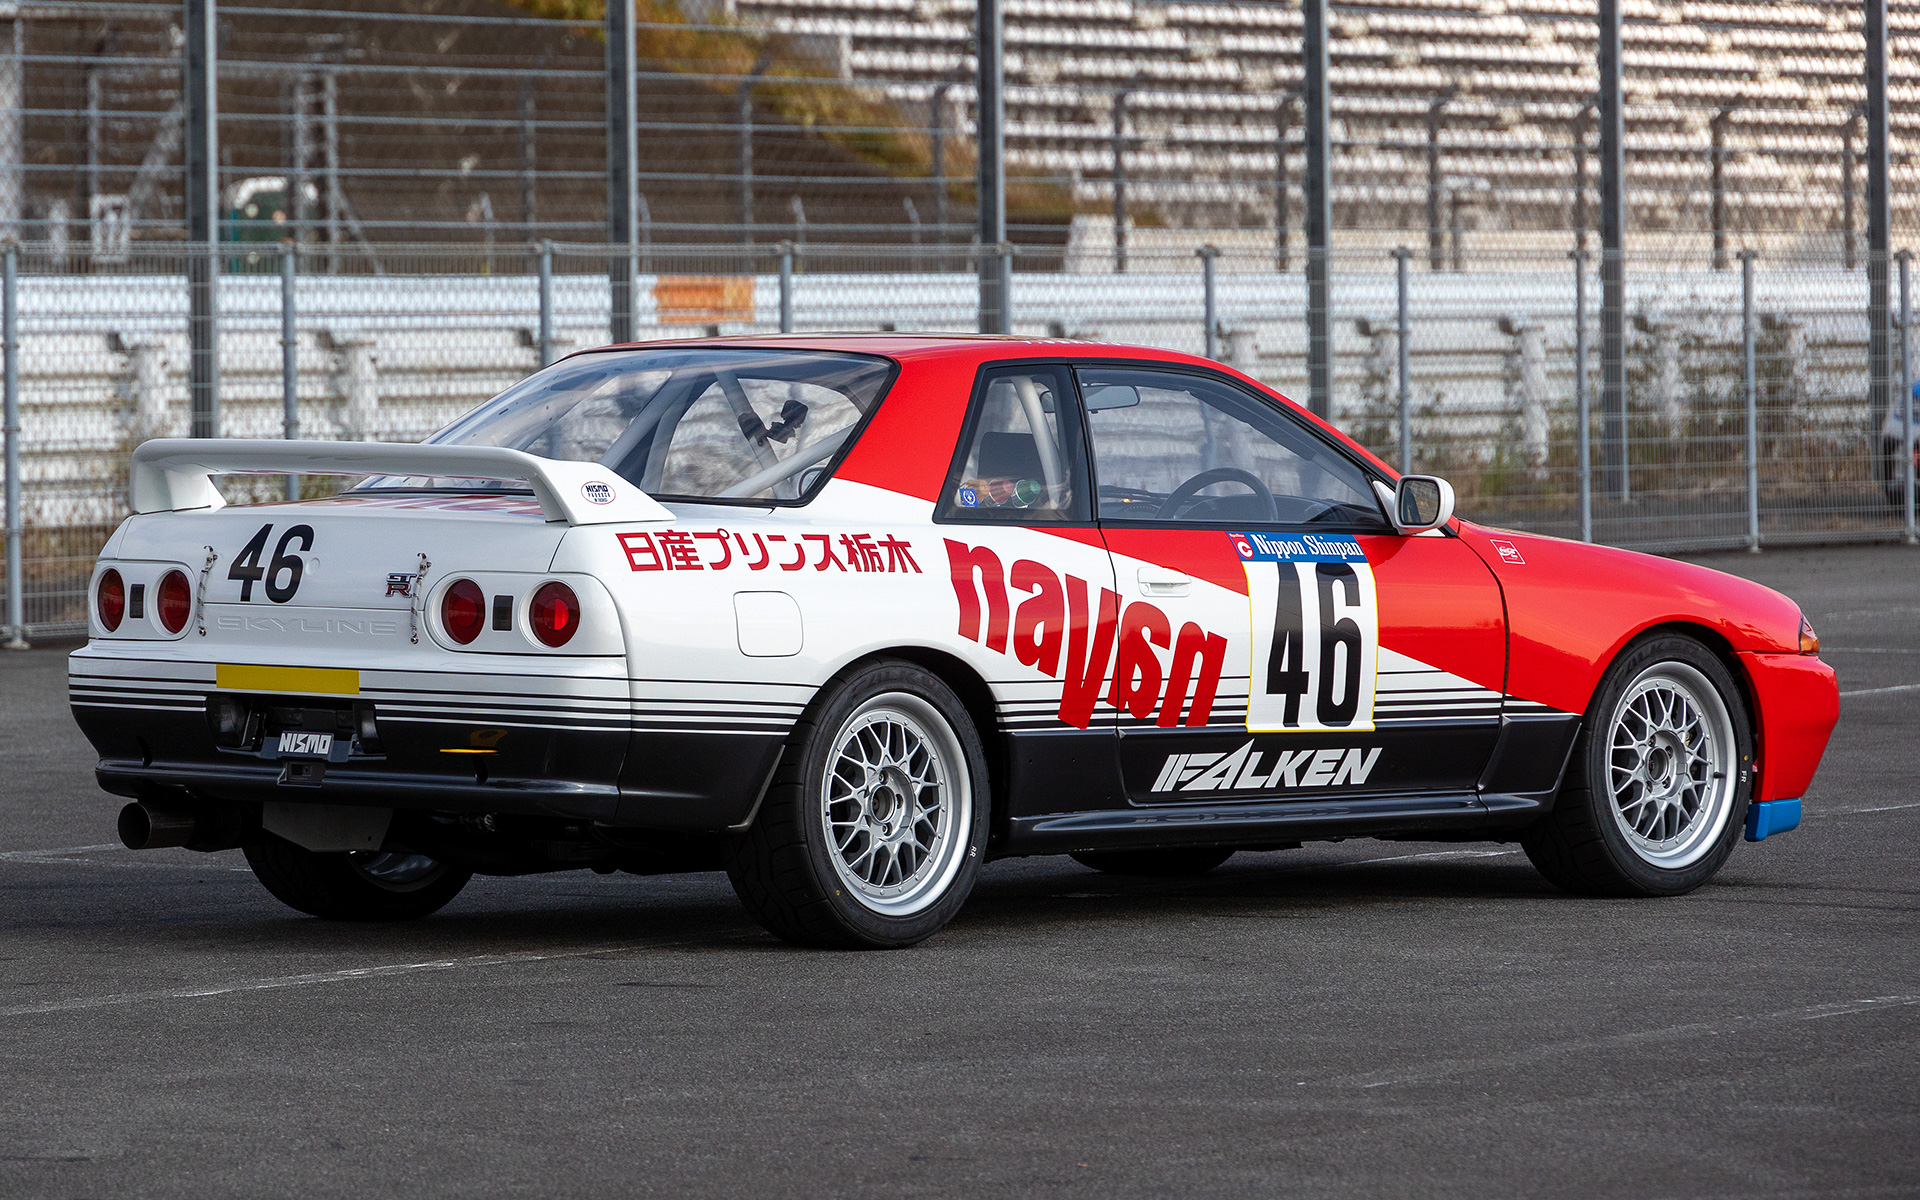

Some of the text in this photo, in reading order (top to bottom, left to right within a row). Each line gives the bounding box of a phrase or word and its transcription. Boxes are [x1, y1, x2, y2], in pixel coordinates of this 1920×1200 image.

[228, 523, 315, 604] 46
[615, 528, 923, 574] 日産プリンス栃木
[1250, 533, 1307, 559] Nippon
[1302, 534, 1365, 560] Shinpan
[217, 615, 397, 636] SKYLINE
[1265, 561, 1362, 728] 46
[278, 732, 332, 755] NISMO
[1150, 738, 1384, 793] FALKEN
